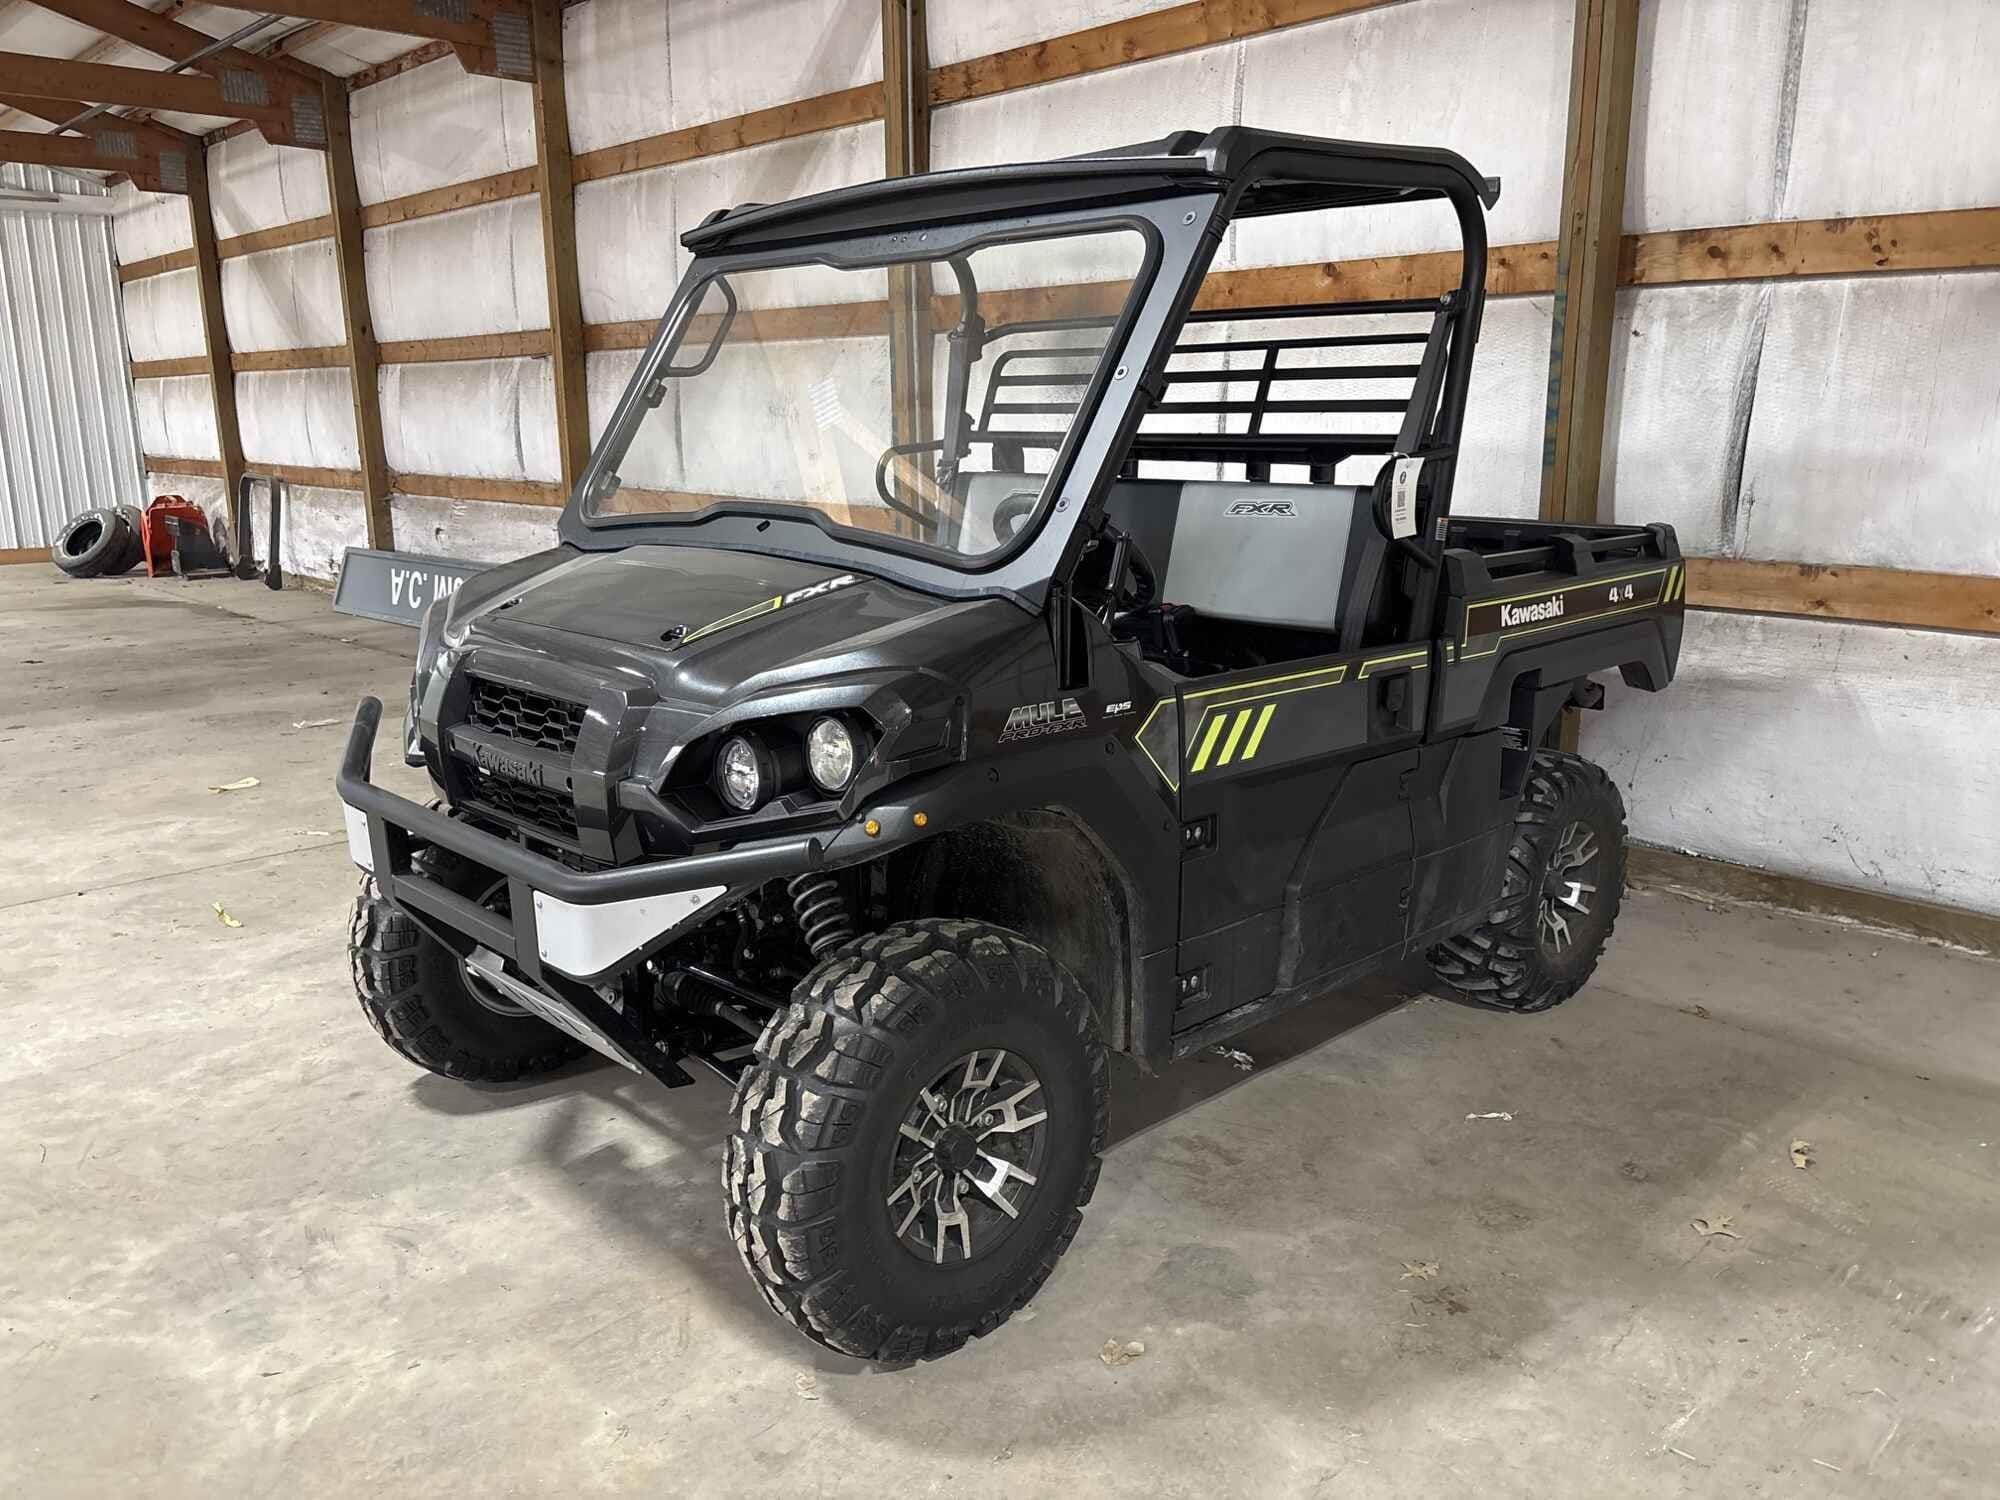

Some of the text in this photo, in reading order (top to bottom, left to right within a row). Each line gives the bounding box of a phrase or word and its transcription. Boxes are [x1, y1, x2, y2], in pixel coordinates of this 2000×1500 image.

[1225, 501, 1296, 517] FXR
[786, 574, 858, 604] FXR
[1500, 594, 1564, 627] Kawasaki
[1003, 698, 1085, 732] MULE
[472, 742, 544, 787] Kawasaki
